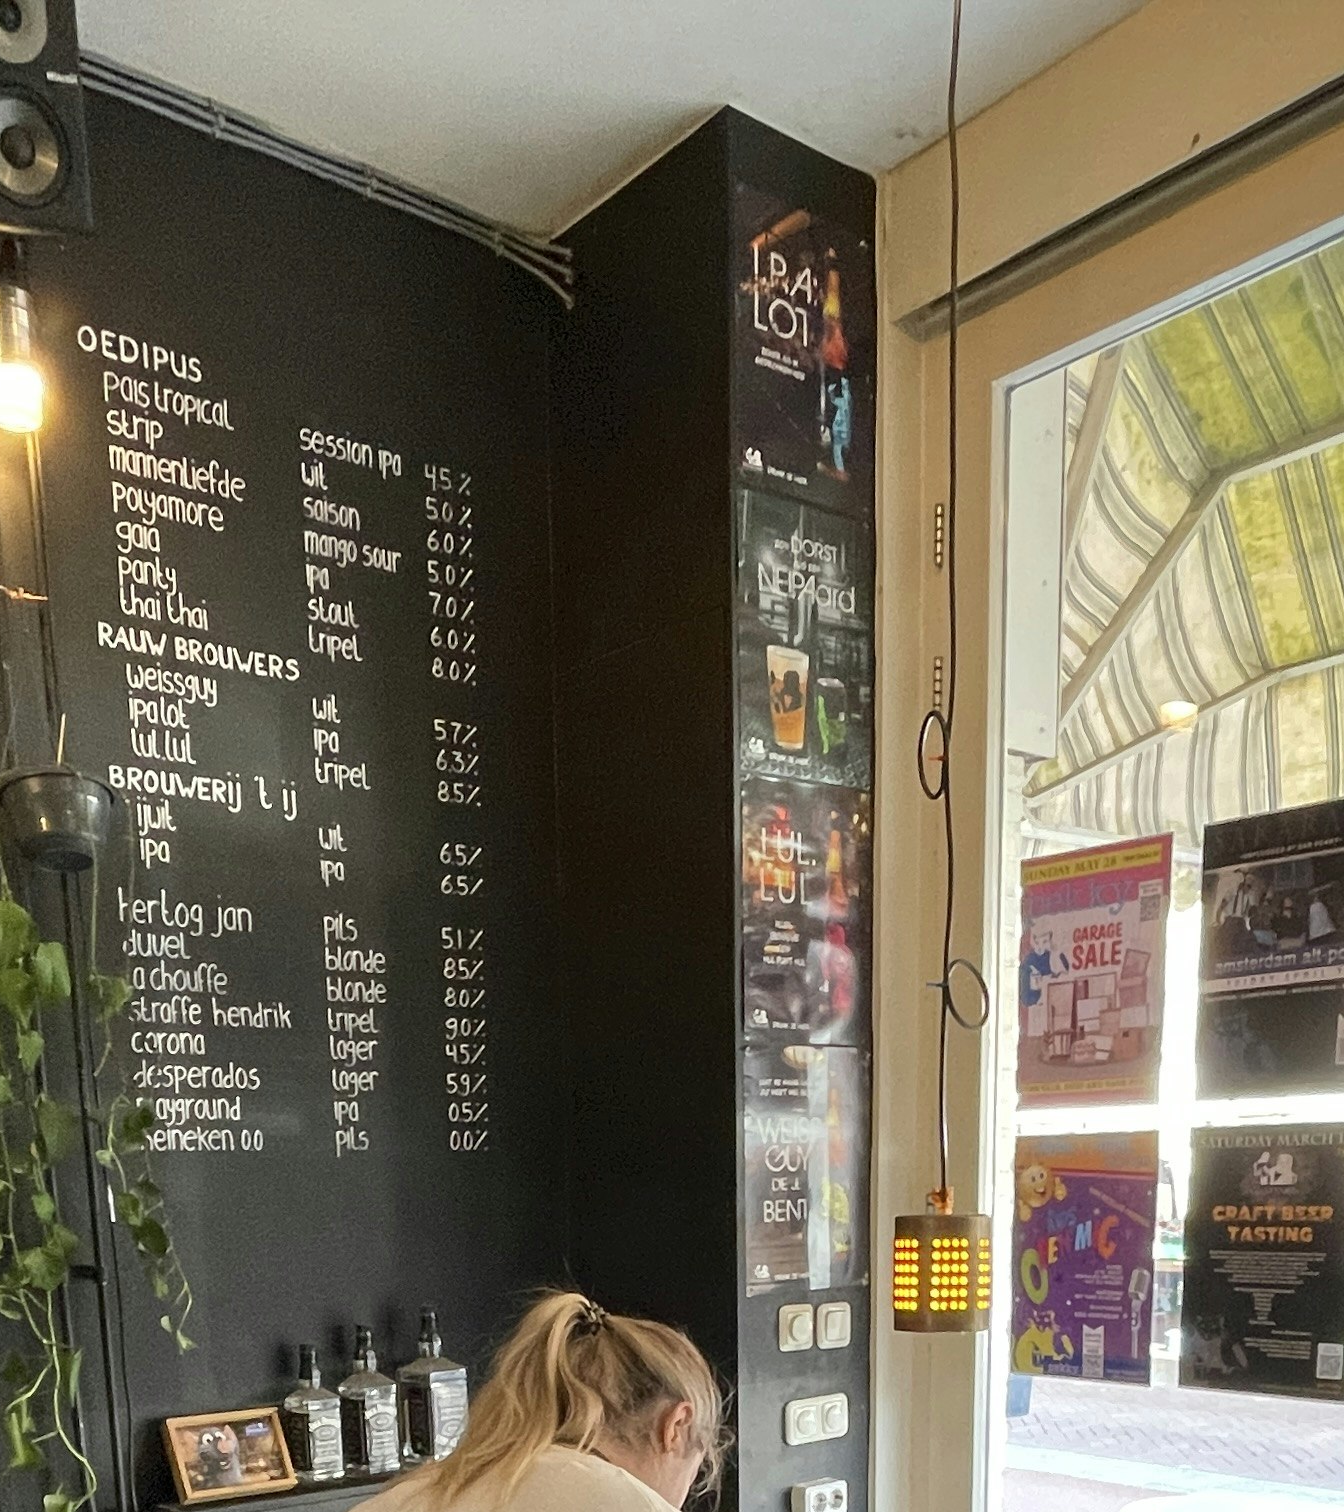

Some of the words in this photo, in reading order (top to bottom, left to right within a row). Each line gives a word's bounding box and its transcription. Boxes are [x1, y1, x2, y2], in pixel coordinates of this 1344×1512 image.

[77, 325, 203, 383] OEDIPUS
[106, 409, 164, 450] strip
[300, 458, 328, 491] wit
[154, 381, 235, 431] tropical
[299, 427, 373, 469] session
[378, 443, 402, 480] ipa
[108, 444, 246, 503] mannenliefde
[303, 494, 361, 532] saison
[112, 481, 225, 531] polyamore
[303, 530, 358, 568] mango
[362, 544, 402, 573] sour
[116, 521, 161, 554] gaia
[306, 557, 330, 594] ipa
[118, 555, 178, 596] panty
[307, 596, 360, 629] stout
[119, 584, 162, 621] thai
[166, 592, 209, 631] thai
[308, 624, 363, 663] tripel
[97, 621, 168, 657] RAUW
[174, 636, 301, 682] BROUWERS
[125, 661, 218, 708] weissguy
[312, 694, 341, 723] wit
[313, 721, 340, 757] ipa
[314, 756, 372, 791] tripel
[318, 822, 348, 852] wit
[140, 837, 170, 870] ipa
[320, 853, 345, 888] ipa
[759, 868, 806, 905] LUL
[210, 894, 253, 938] jan
[322, 910, 358, 945] pils
[1072, 922, 1123, 944] GARAGE
[324, 946, 387, 974] blonde
[1072, 941, 1123, 970] SALE
[149, 960, 229, 995] chouffe
[326, 976, 387, 1004] blonde
[128, 995, 202, 1025] straffe
[212, 996, 292, 1029] hendrik
[327, 1007, 380, 1039] tripel
[131, 1032, 206, 1055] corona
[329, 1034, 378, 1068] lager
[133, 1059, 261, 1094] desperados
[331, 1068, 379, 1098] lager
[136, 1096, 242, 1127] ayground
[334, 1101, 359, 1126] ipa
[335, 1126, 370, 1158] pils
[1201, 1134, 1273, 1149] SATURDAY
[1276, 1133, 1333, 1147] MARCH
[1212, 1204, 1277, 1222] CRAFT
[1227, 1225, 1314, 1243] TASTING
